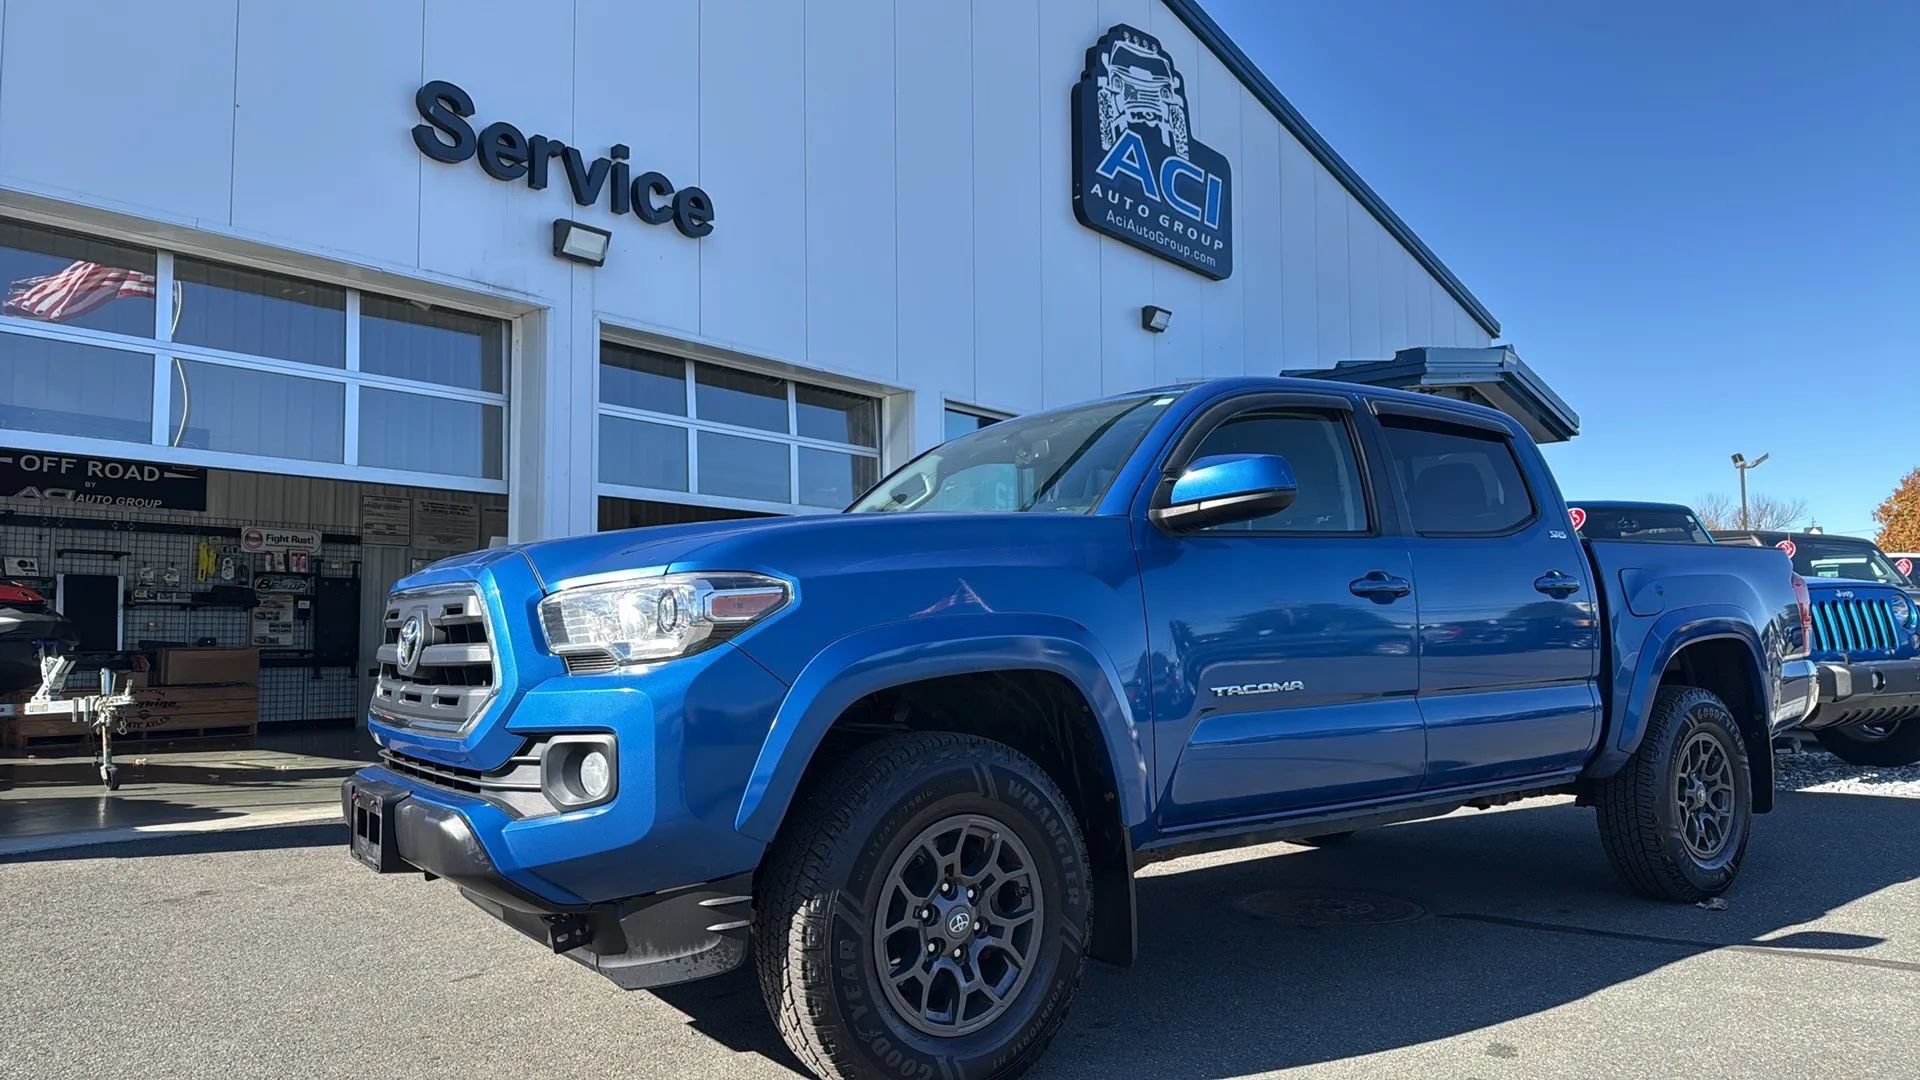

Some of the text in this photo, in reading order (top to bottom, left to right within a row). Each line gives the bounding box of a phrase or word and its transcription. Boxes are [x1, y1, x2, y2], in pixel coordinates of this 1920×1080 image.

[411, 80, 715, 239] Service
[1096, 129, 1222, 230] ACI
[1091, 183, 1224, 250] AUTO GROUP
[1106, 209, 1216, 268] AciAutoGroup.com
[19, 454, 160, 482] OFF ROAD
[84, 481, 96, 489] BY
[13, 486, 163, 509] ACI AUTO GROUP
[265, 533, 289, 544] Fight
[291, 535, 314, 545] Rust!
[1209, 680, 1305, 697] TACOMA
[1007, 779, 1080, 905] WRANGLER
